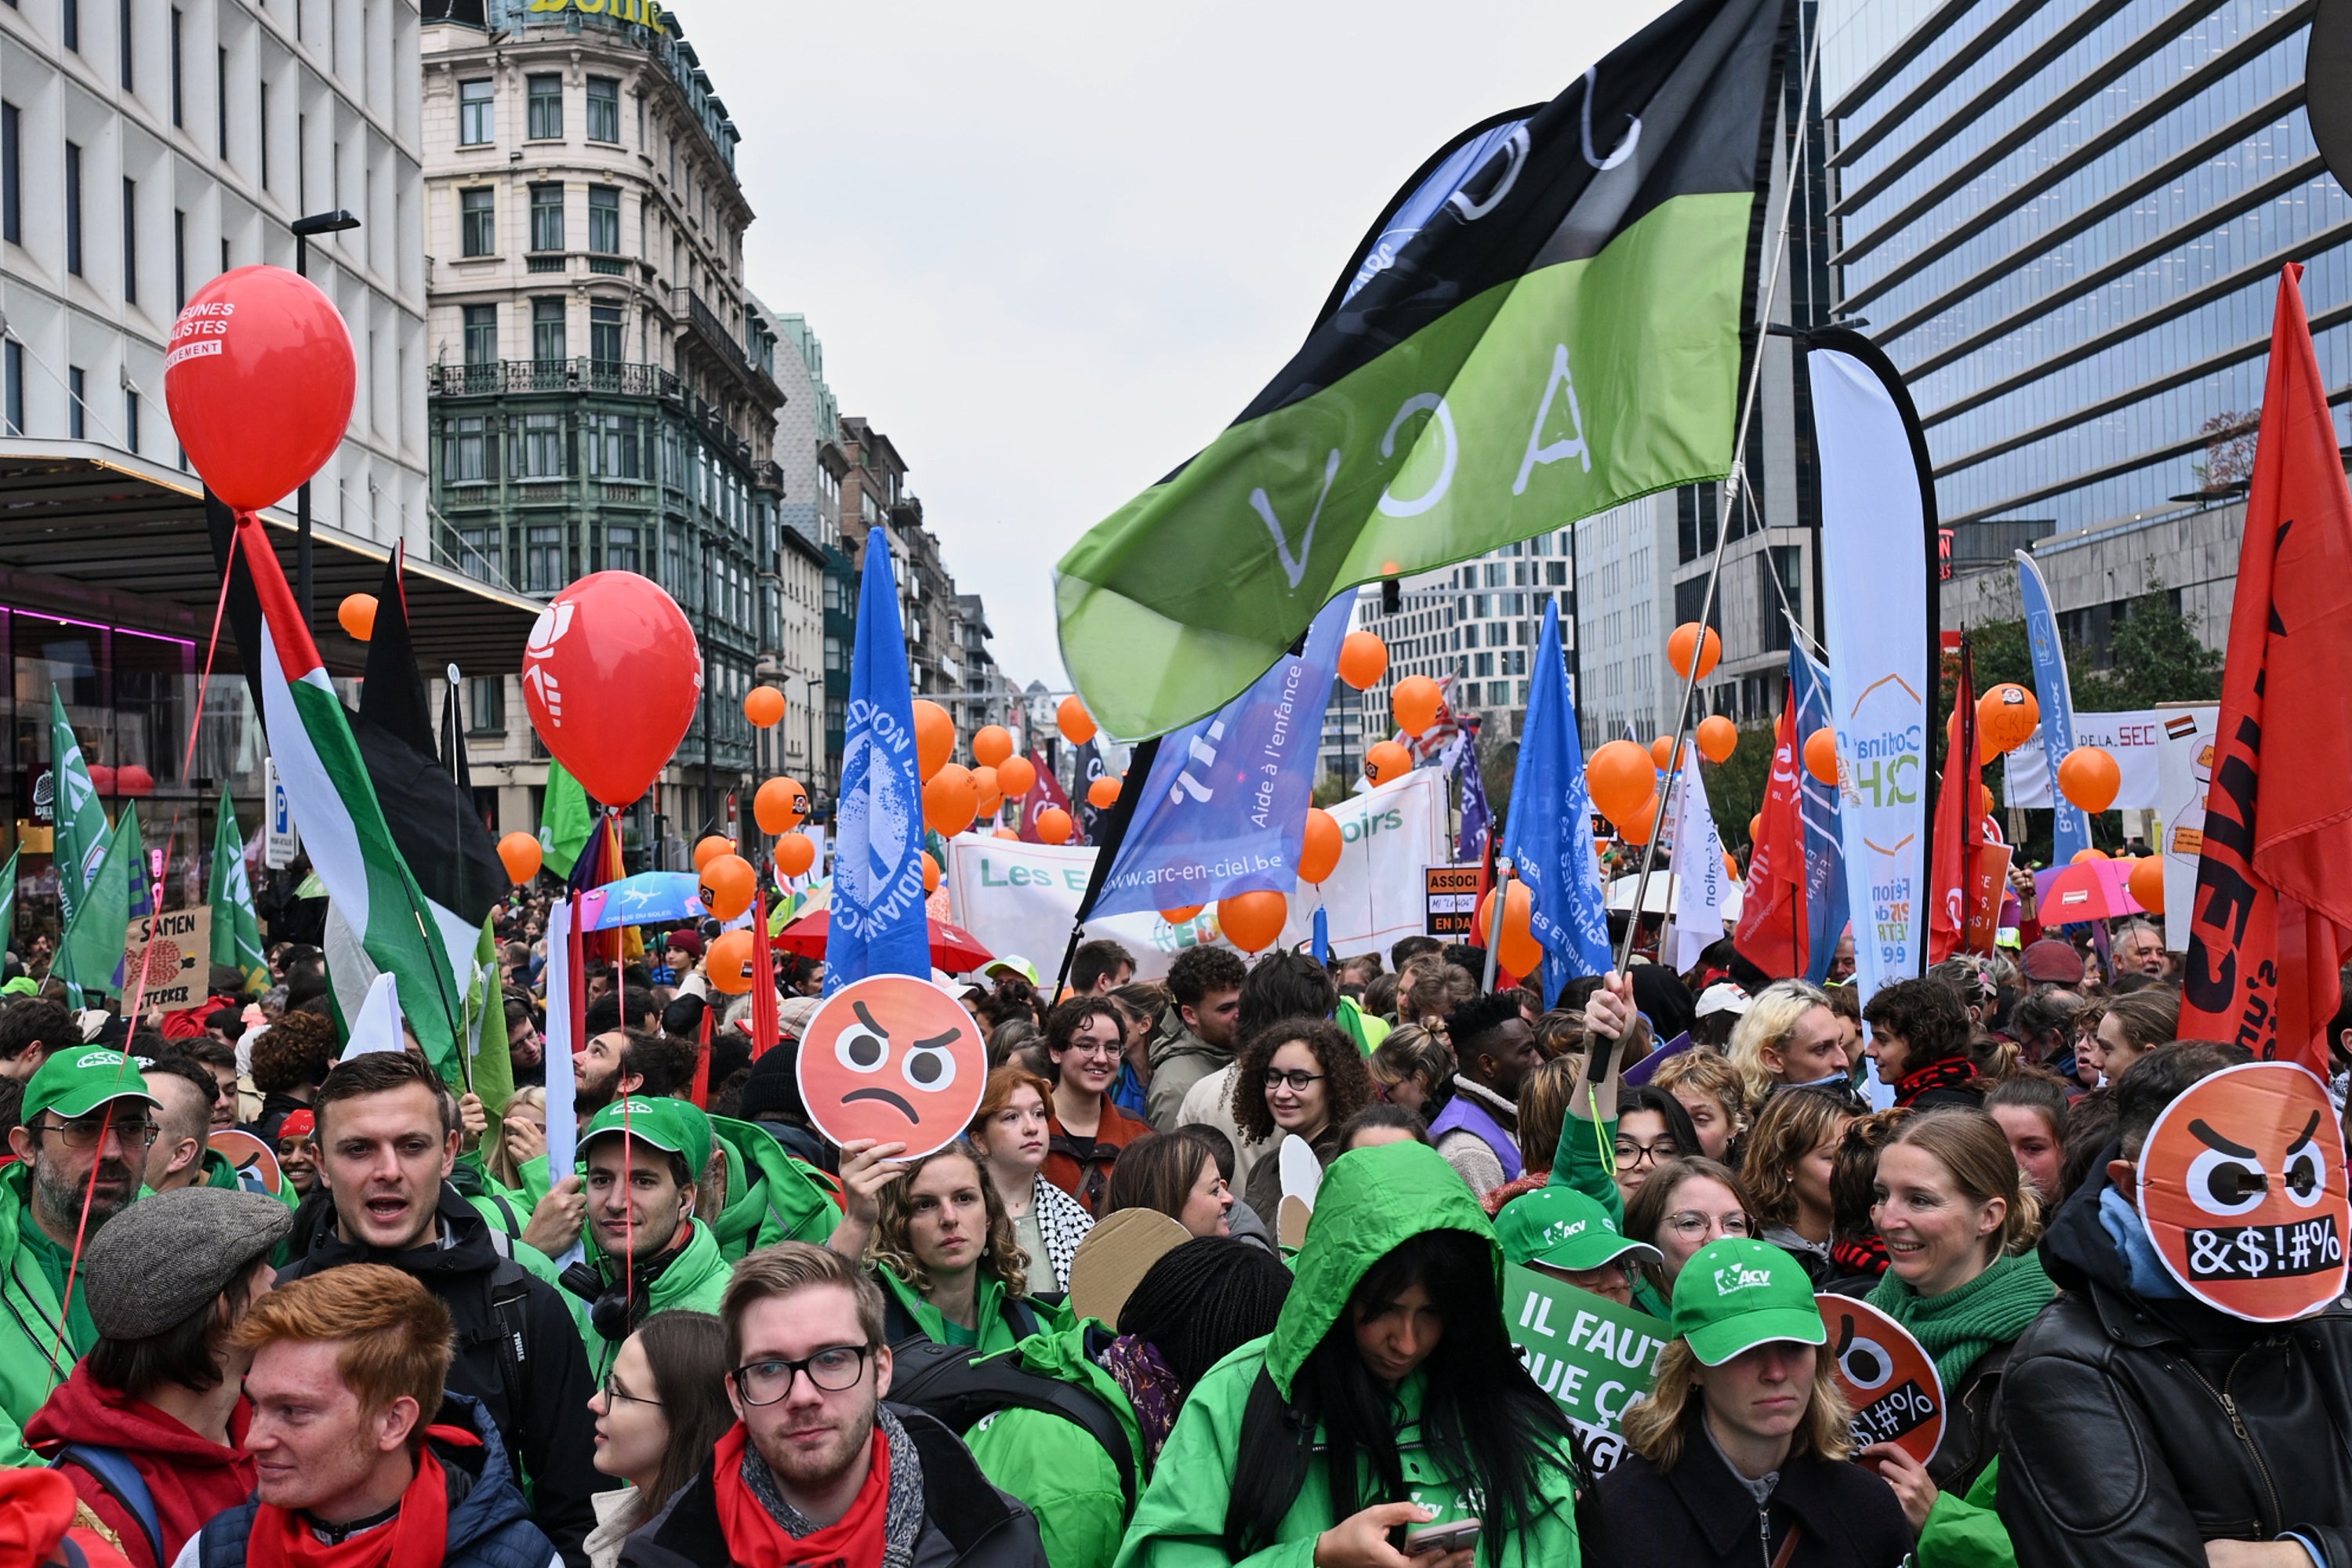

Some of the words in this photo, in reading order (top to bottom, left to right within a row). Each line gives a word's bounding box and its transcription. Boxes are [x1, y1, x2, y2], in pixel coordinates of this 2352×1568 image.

[1252, 781, 1274, 828] Aide
[1265, 665, 1302, 757] l'enfance
[2119, 725, 2155, 746] SEC
[981, 858, 1053, 887] Les
[1341, 808, 1403, 844] oirs
[1430, 875, 1479, 887] ASSOCI
[648, 909, 673, 918] SOLEIL
[140, 914, 195, 942] SAMEN
[1550, 926, 1603, 978] ETUDIAN
[138, 985, 189, 1011] TERKER
[1563, 1219, 1586, 1240] ACV
[1738, 1269, 1771, 1284] ACV
[1519, 1291, 1556, 1338] IL
